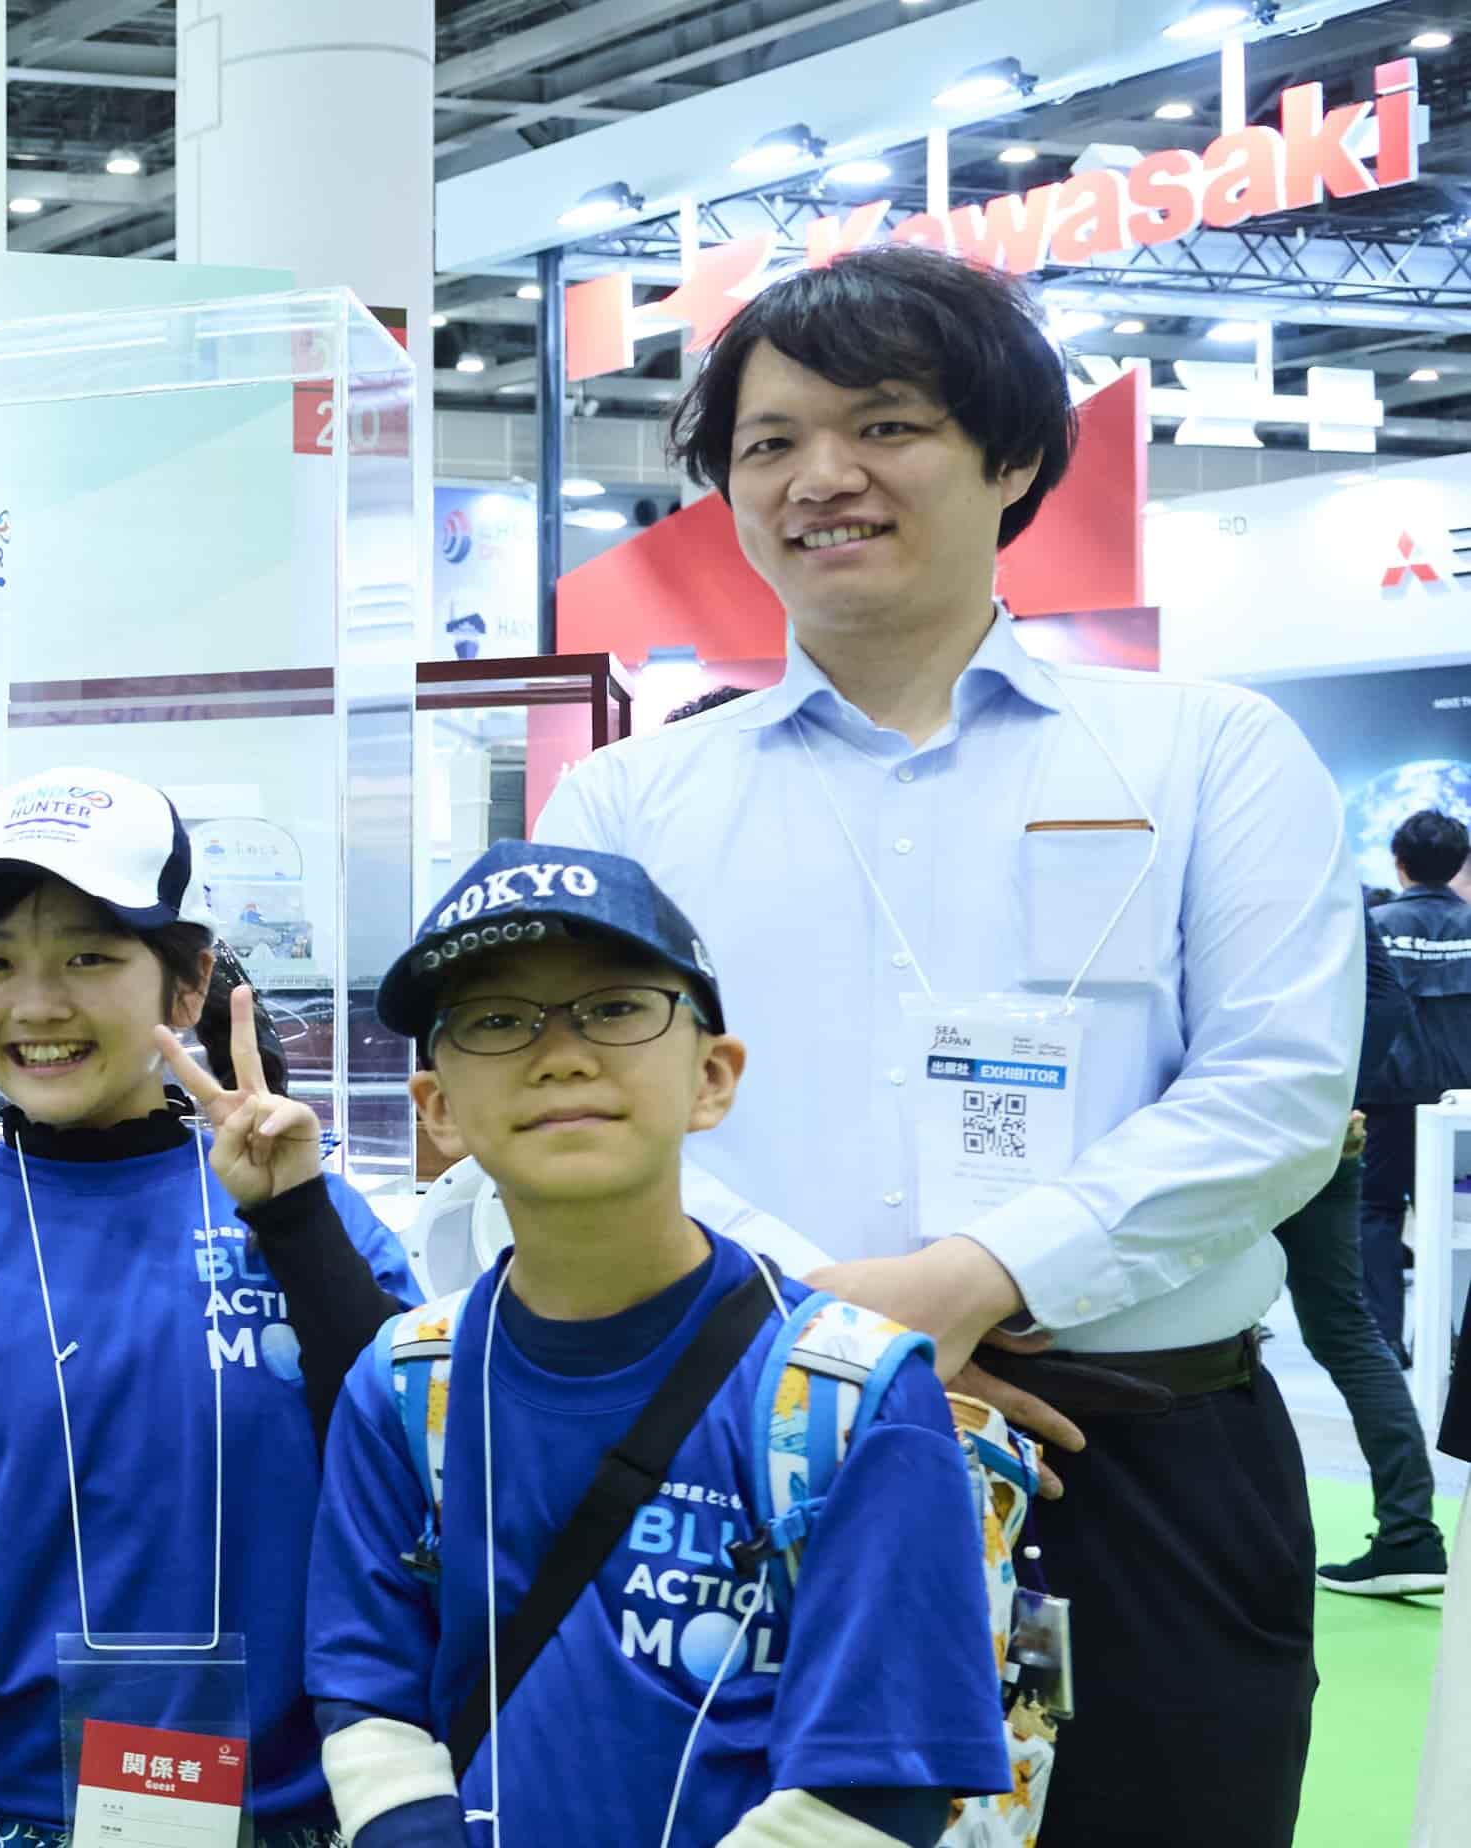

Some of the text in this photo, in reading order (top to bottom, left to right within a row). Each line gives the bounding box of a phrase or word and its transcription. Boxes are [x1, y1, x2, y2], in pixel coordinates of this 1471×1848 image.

[10, 800, 91, 818] HUNTER
[437, 864, 599, 929] TOKYO
[935, 1026, 958, 1036] SEA
[930, 1035, 972, 1050] JAPAN
[980, 1064, 1059, 1083] EXHIBITOR
[620, 1608, 782, 1683] MOL
[122, 1751, 203, 1784] 関係者
[144, 1778, 177, 1793] Guest
